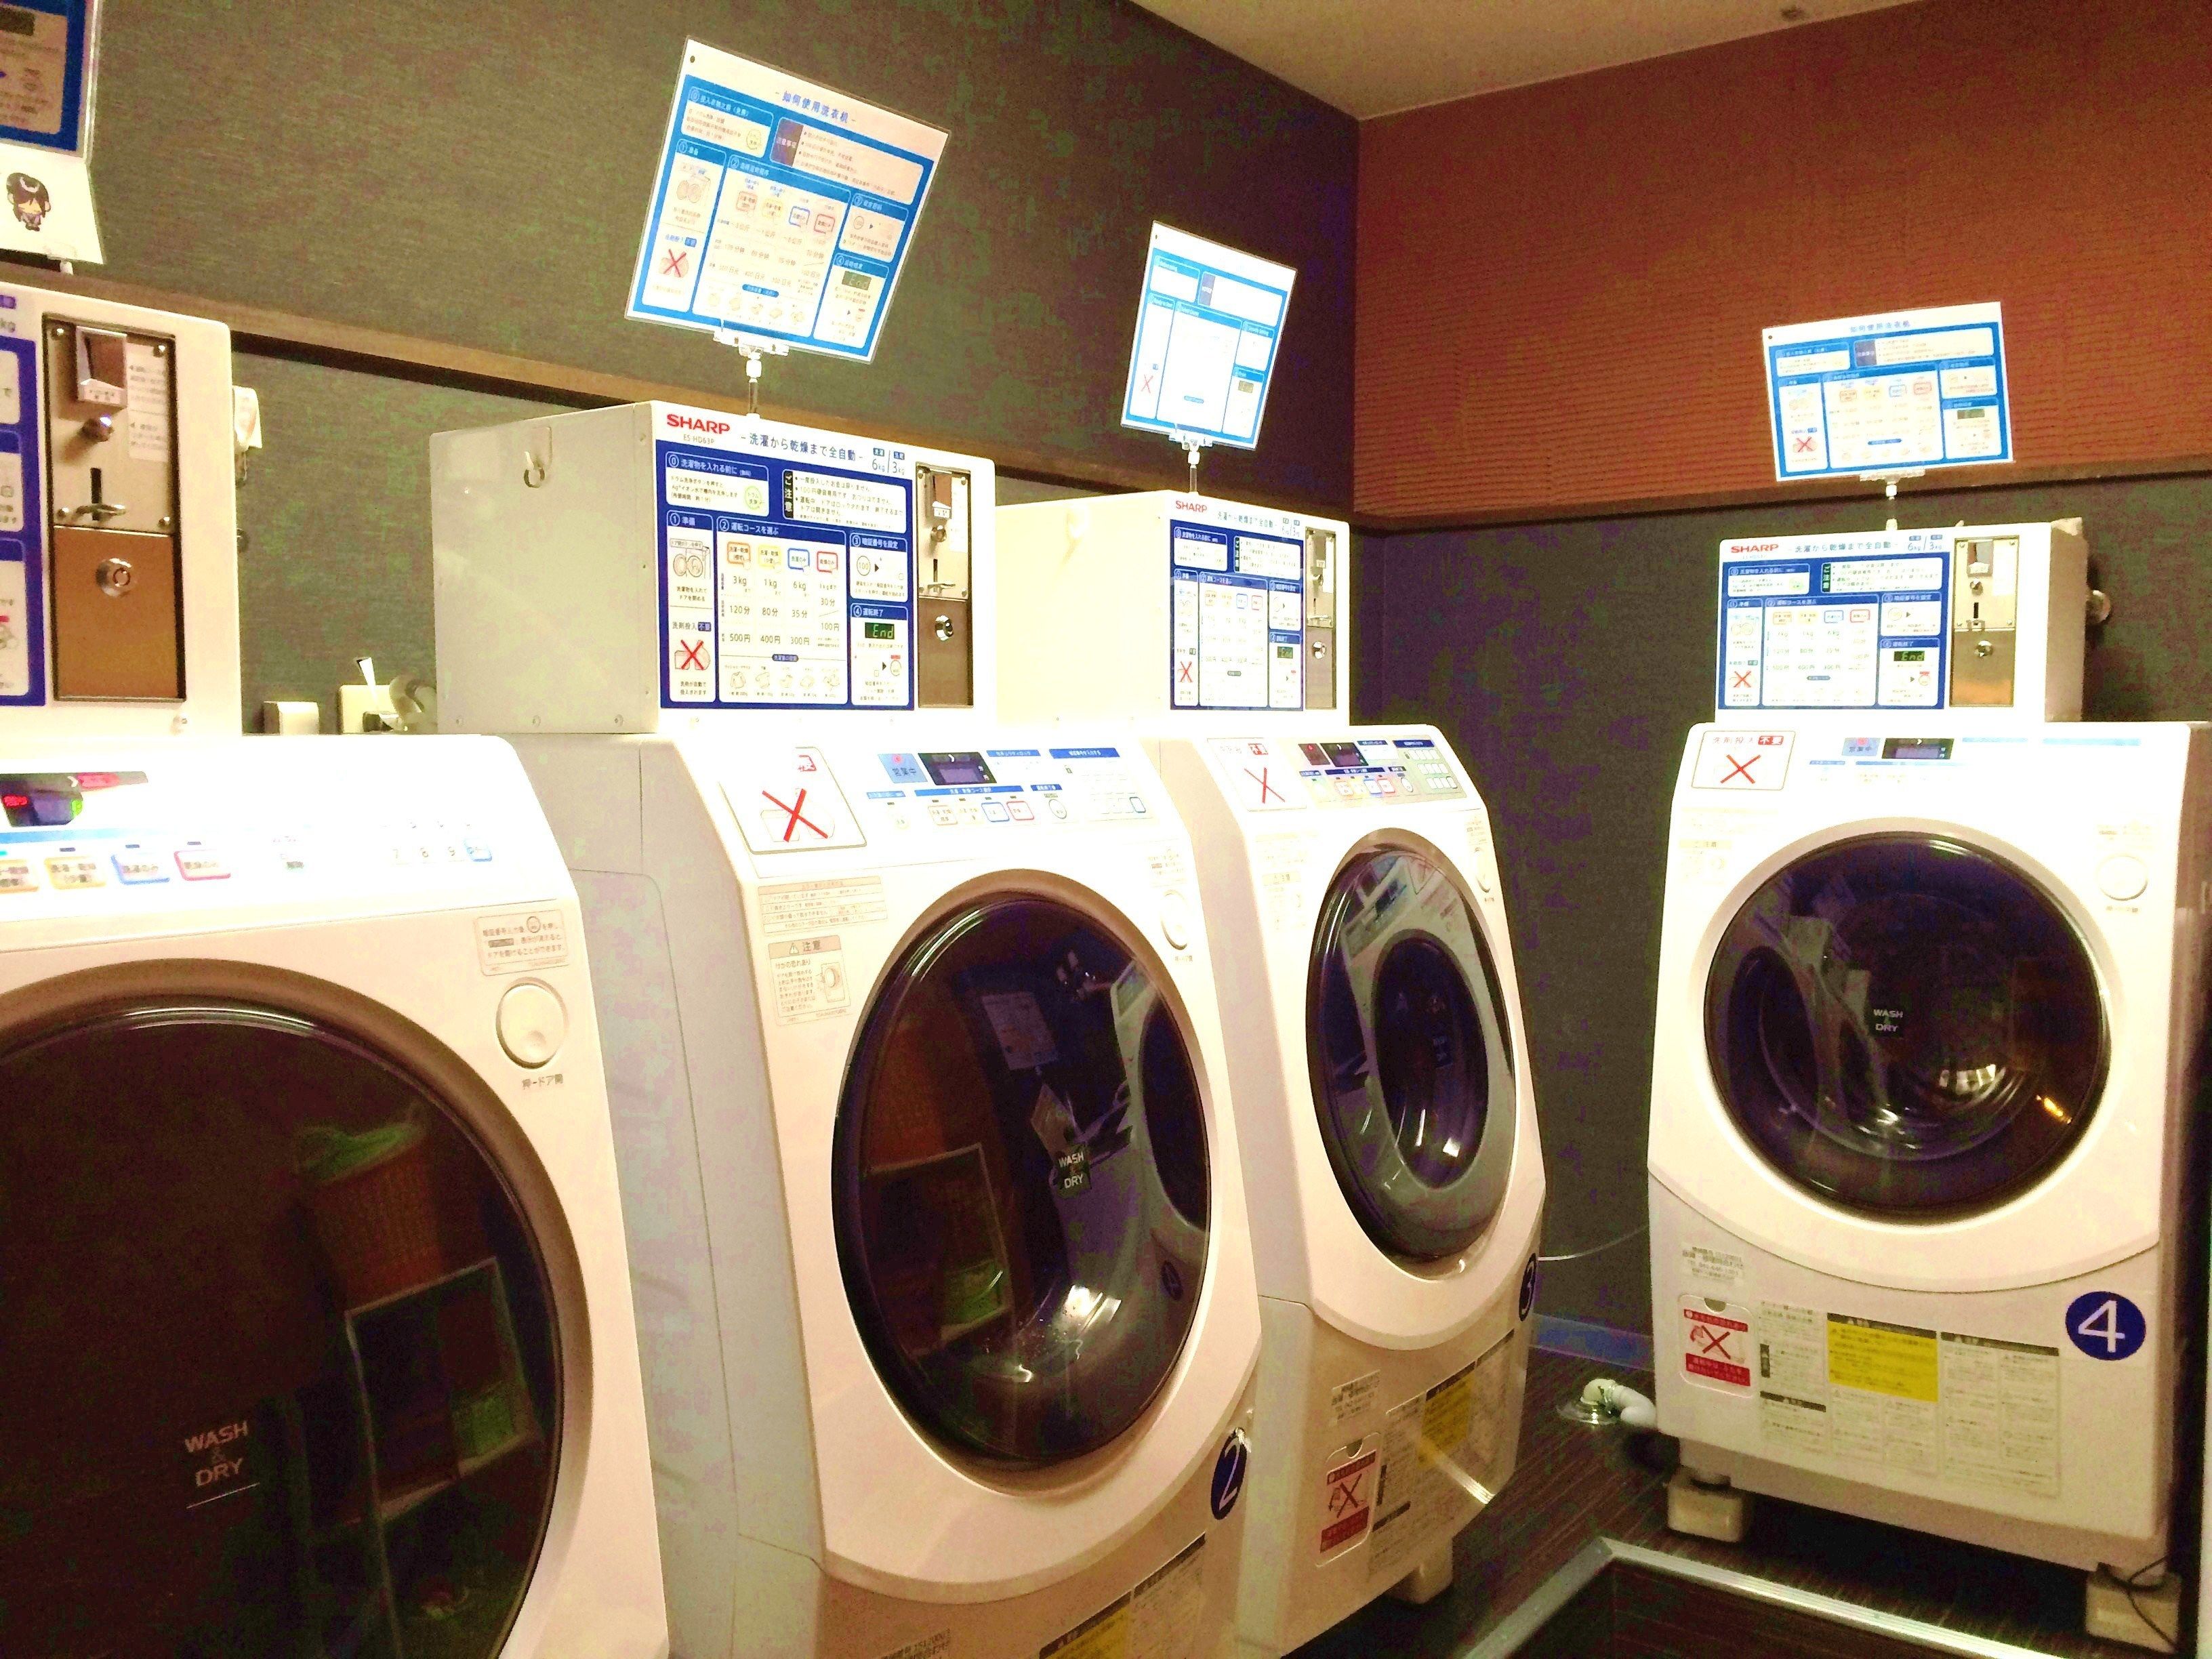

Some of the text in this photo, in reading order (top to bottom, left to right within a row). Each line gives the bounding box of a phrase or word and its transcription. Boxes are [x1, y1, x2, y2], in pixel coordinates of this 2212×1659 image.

[667, 413, 731, 434] SHARP
[750, 432, 856, 462] 洗濯から乾燥まで全自動
[872, 458, 885, 472] 6kg
[893, 461, 905, 476] 3kg
[1175, 499, 1208, 513] SHARP
[1731, 543, 1779, 554] SHARP
[733, 576, 747, 587] 3kg
[764, 578, 777, 588] 1kg
[793, 581, 806, 591] 6kg
[821, 598, 835, 607] 30分
[730, 605, 750, 615] 120分
[762, 607, 778, 617] 80分
[792, 609, 808, 618] 35分
[821, 623, 840, 632] 100円
[873, 623, 895, 639] End
[730, 634, 751, 643] 500円
[760, 635, 781, 644] 400円
[790, 636, 810, 645] 300円
[1900, 651, 1925, 661] End
[1873, 1008, 1904, 1019] WASH
[1875, 1023, 1898, 1032] DRY
[1059, 1151, 1084, 1168] WASH
[1064, 1174, 1084, 1189] DRY
[2077, 1300, 2125, 1353] 4
[184, 1420, 248, 1453] WASH
[195, 1458, 243, 1488] DRY
